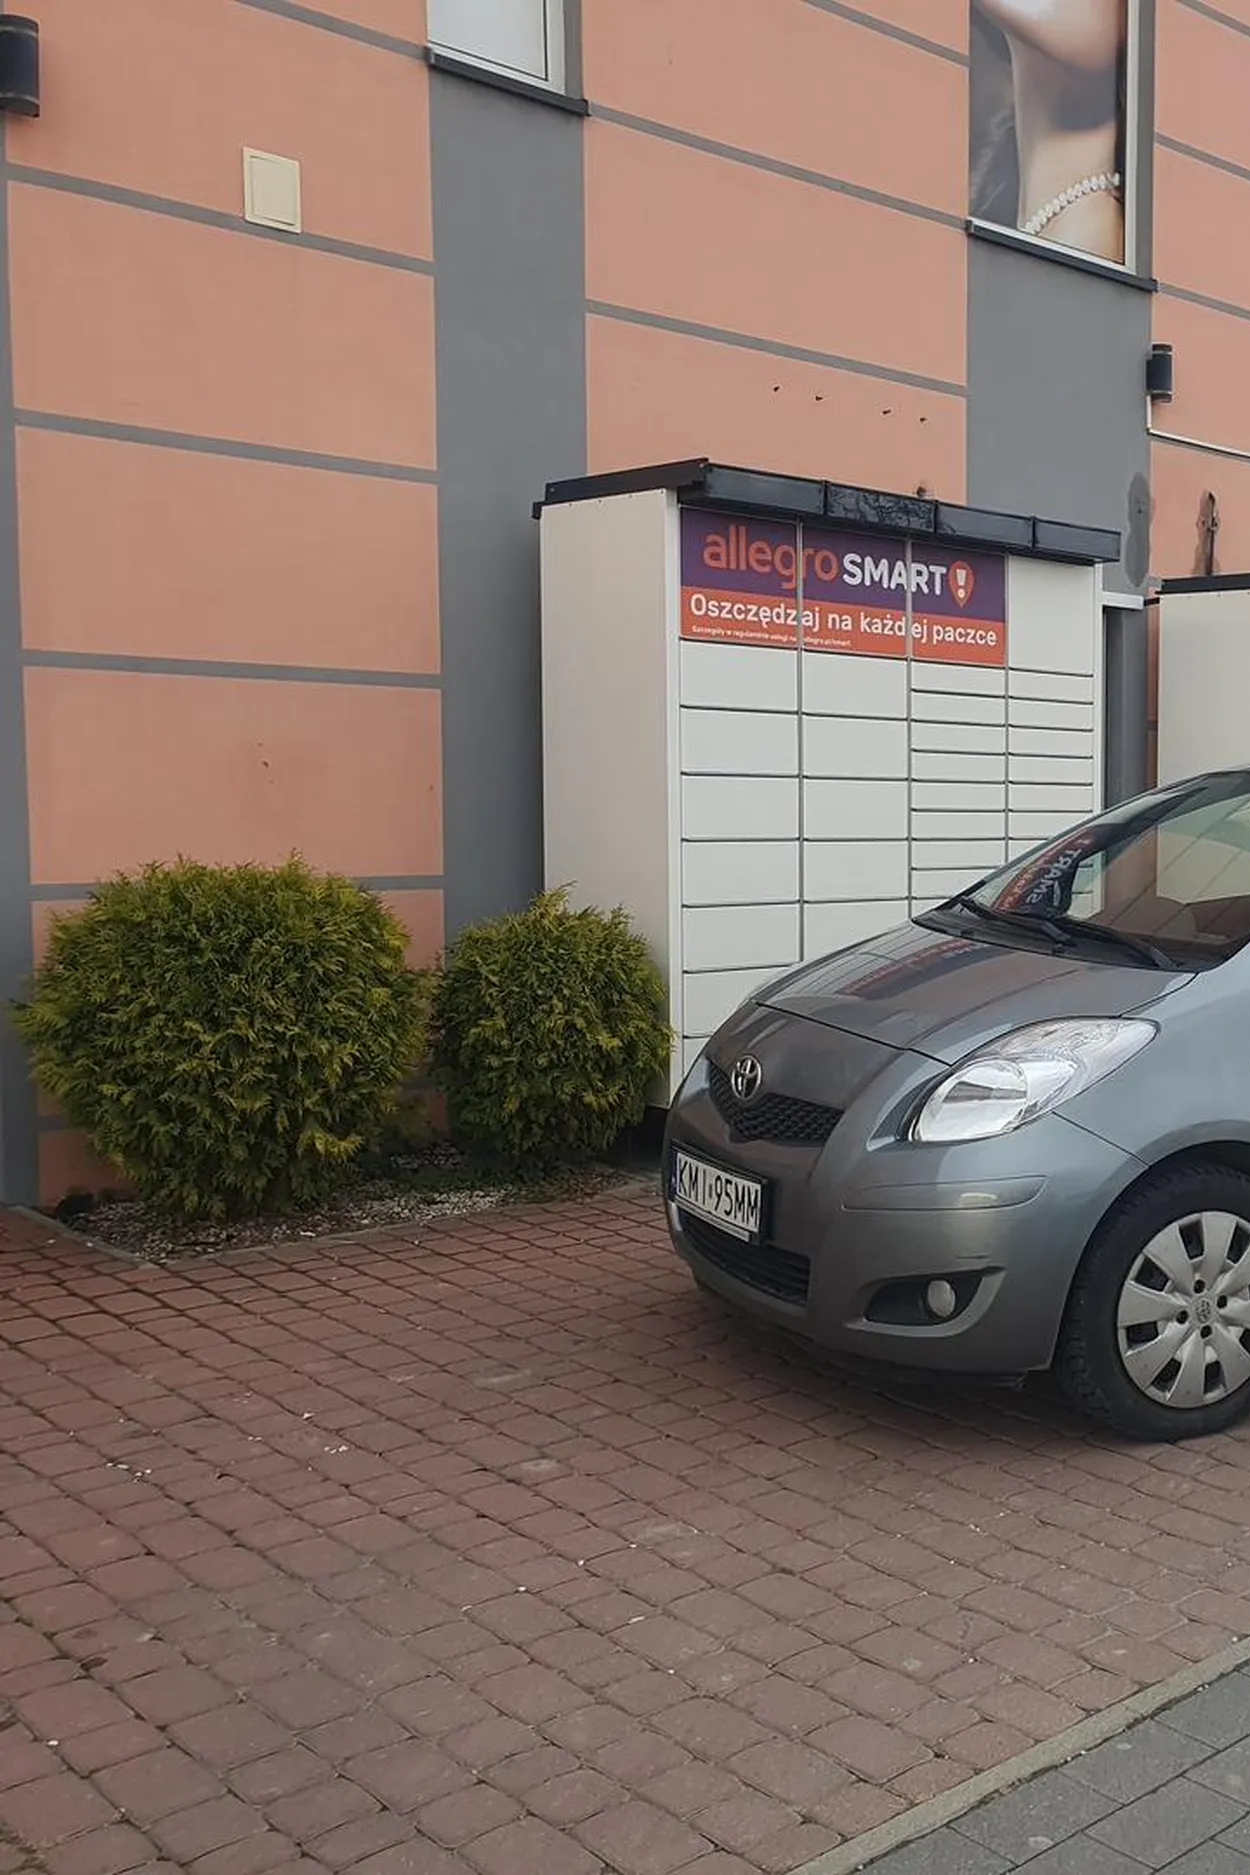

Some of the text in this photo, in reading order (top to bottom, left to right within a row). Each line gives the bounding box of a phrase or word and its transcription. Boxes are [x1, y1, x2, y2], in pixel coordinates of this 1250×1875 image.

[702, 524, 839, 590] allegro
[690, 593, 997, 646] Oszczędzaj na każdej paczce
[714, 1174, 759, 1228] 95MM
